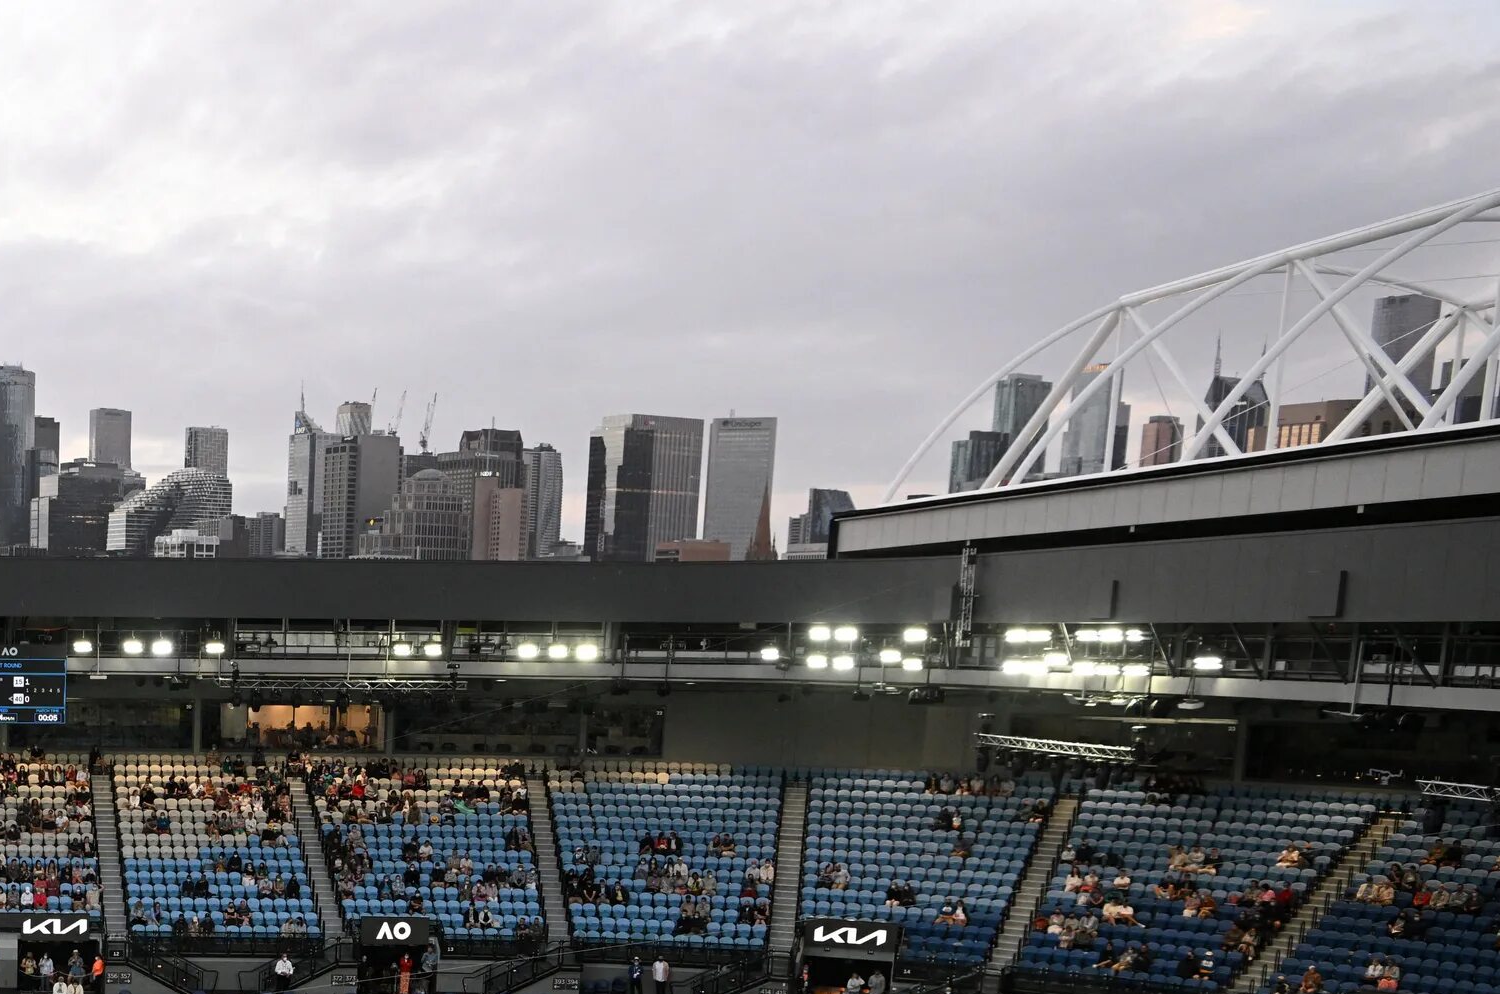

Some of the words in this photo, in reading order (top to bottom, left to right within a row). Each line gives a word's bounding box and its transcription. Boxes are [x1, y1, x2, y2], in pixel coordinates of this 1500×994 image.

[1, 647, 18, 656] AO
[23, 919, 87, 934] KIA
[376, 922, 411, 939] AO
[814, 926, 886, 945] KIA
